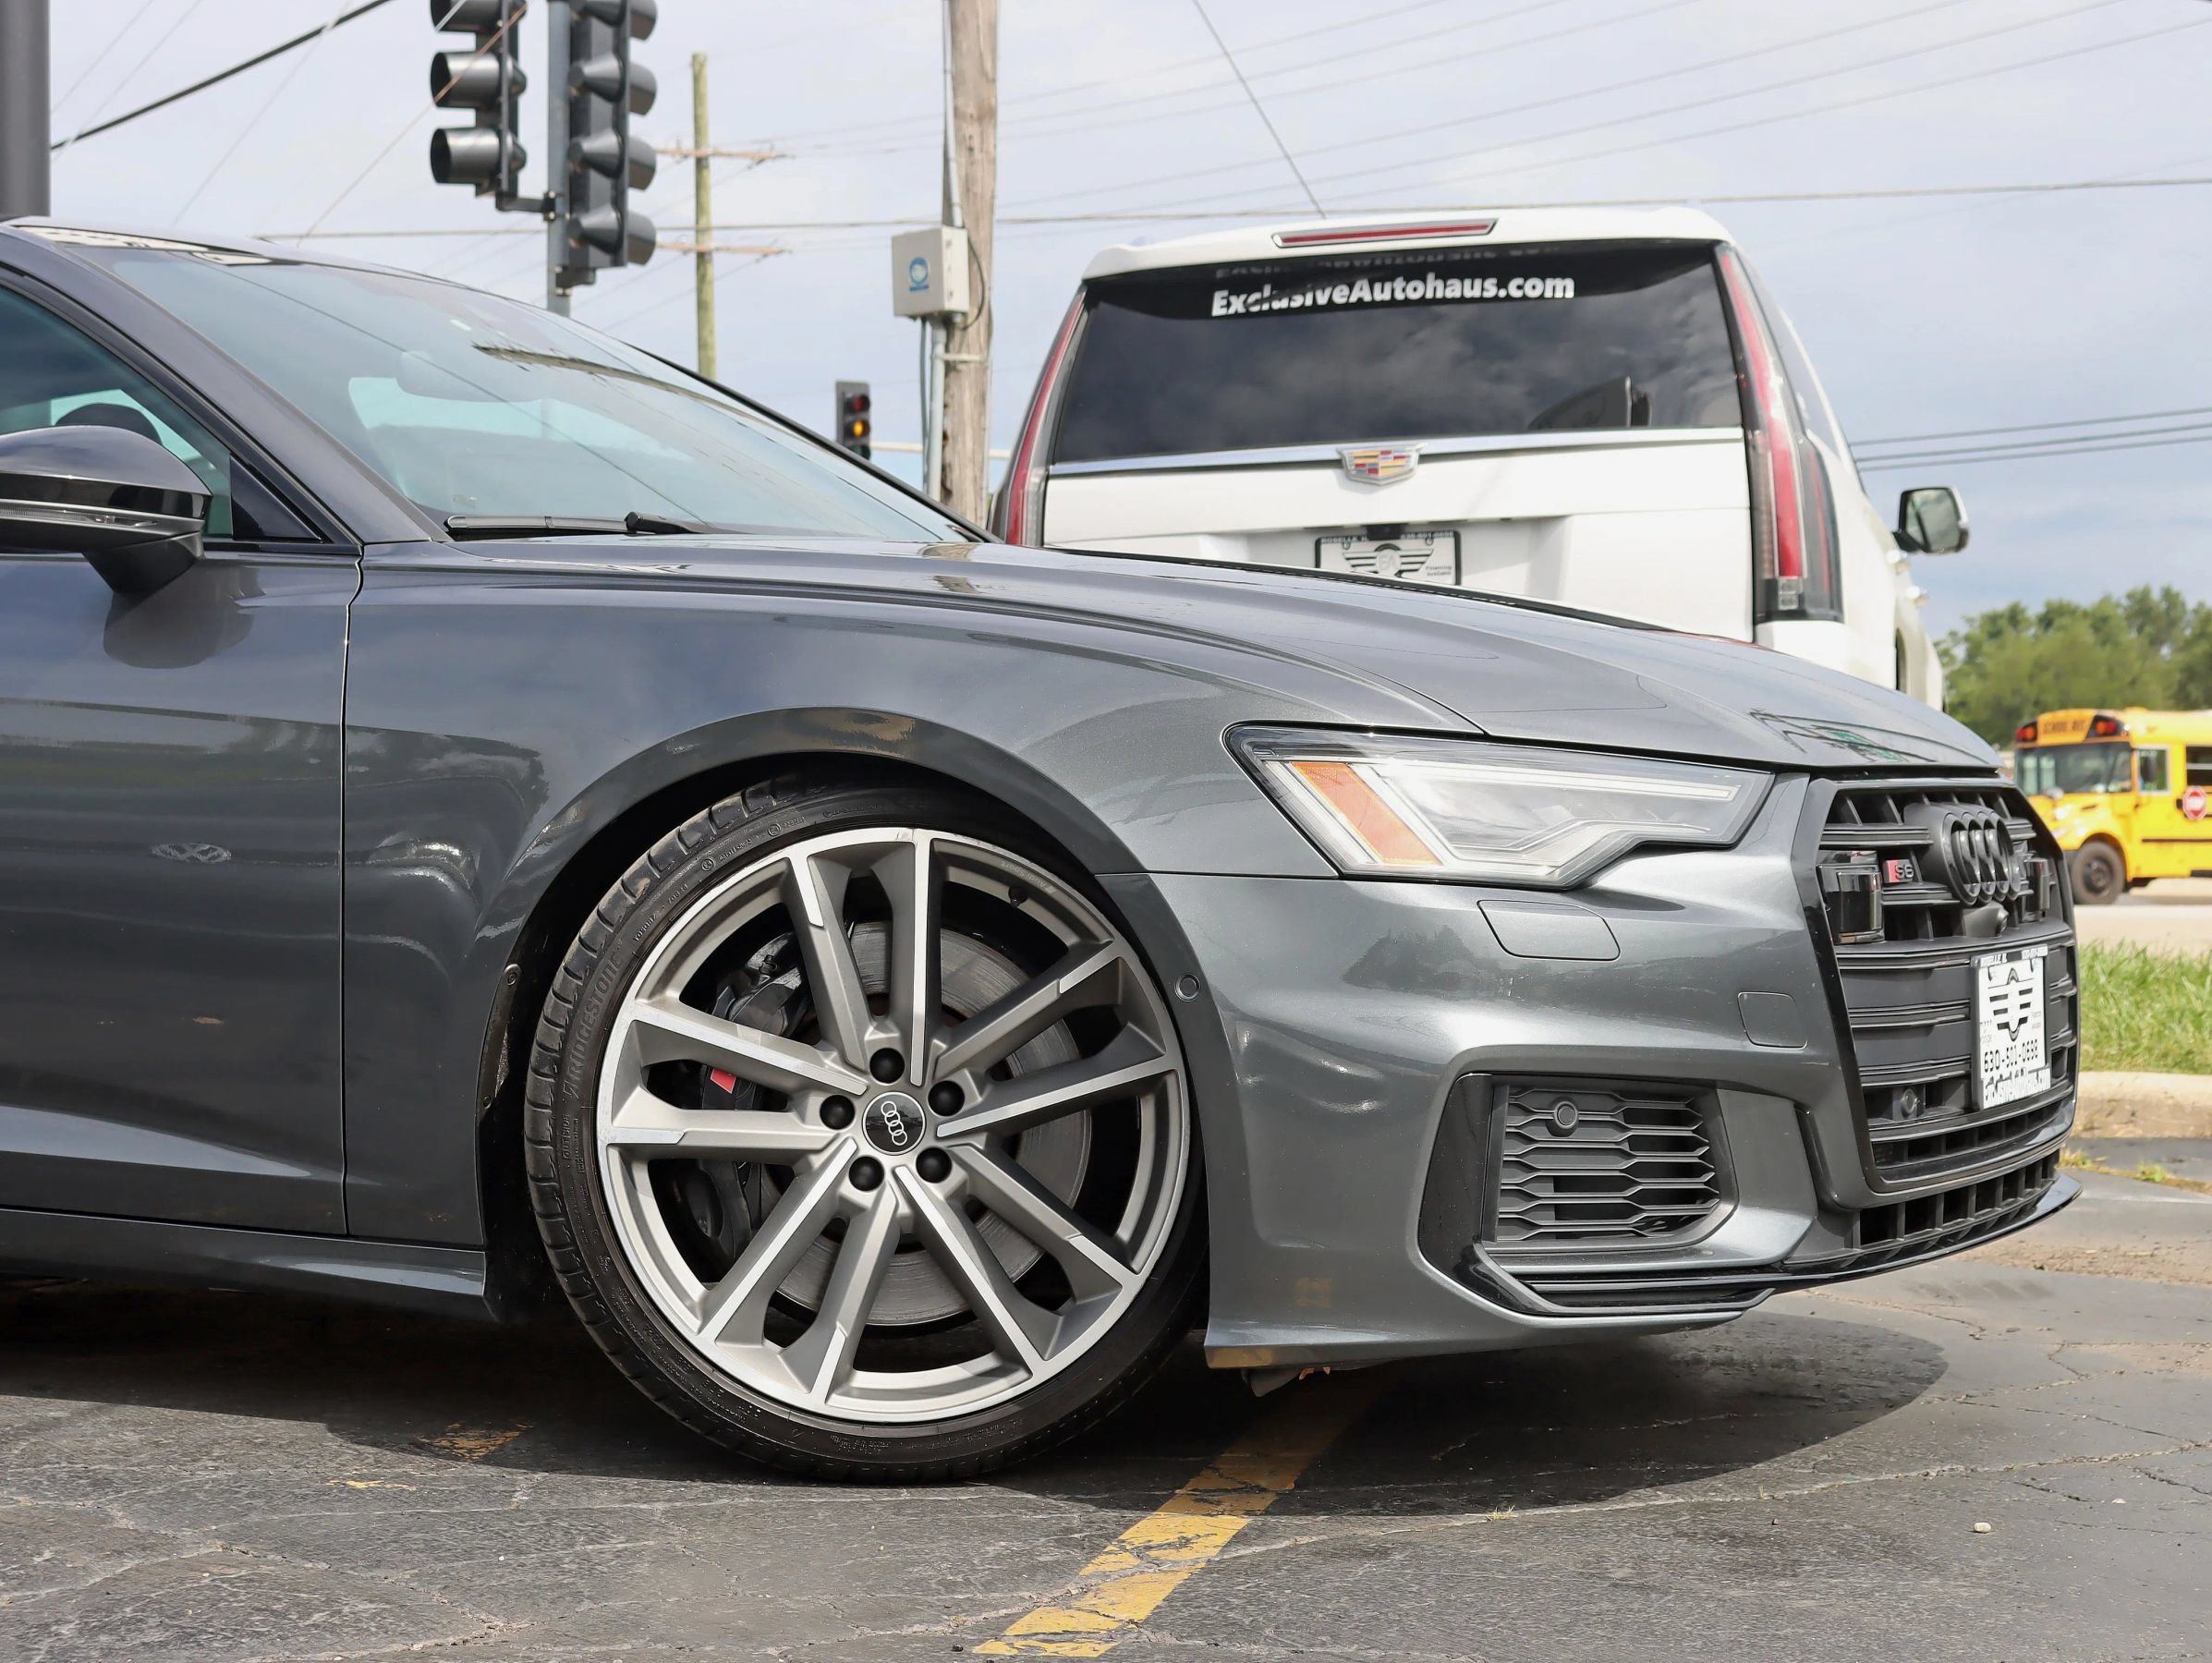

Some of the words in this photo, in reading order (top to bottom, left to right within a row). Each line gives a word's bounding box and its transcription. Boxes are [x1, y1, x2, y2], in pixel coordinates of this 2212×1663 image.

[1211, 272, 1574, 317] ExclusiveAutohaus.com
[1001, 861, 1026, 876] Sport
[1894, 864, 1914, 880] S6
[1027, 872, 1048, 888] Audi
[562, 949, 626, 1098] BRIDGESTONE
